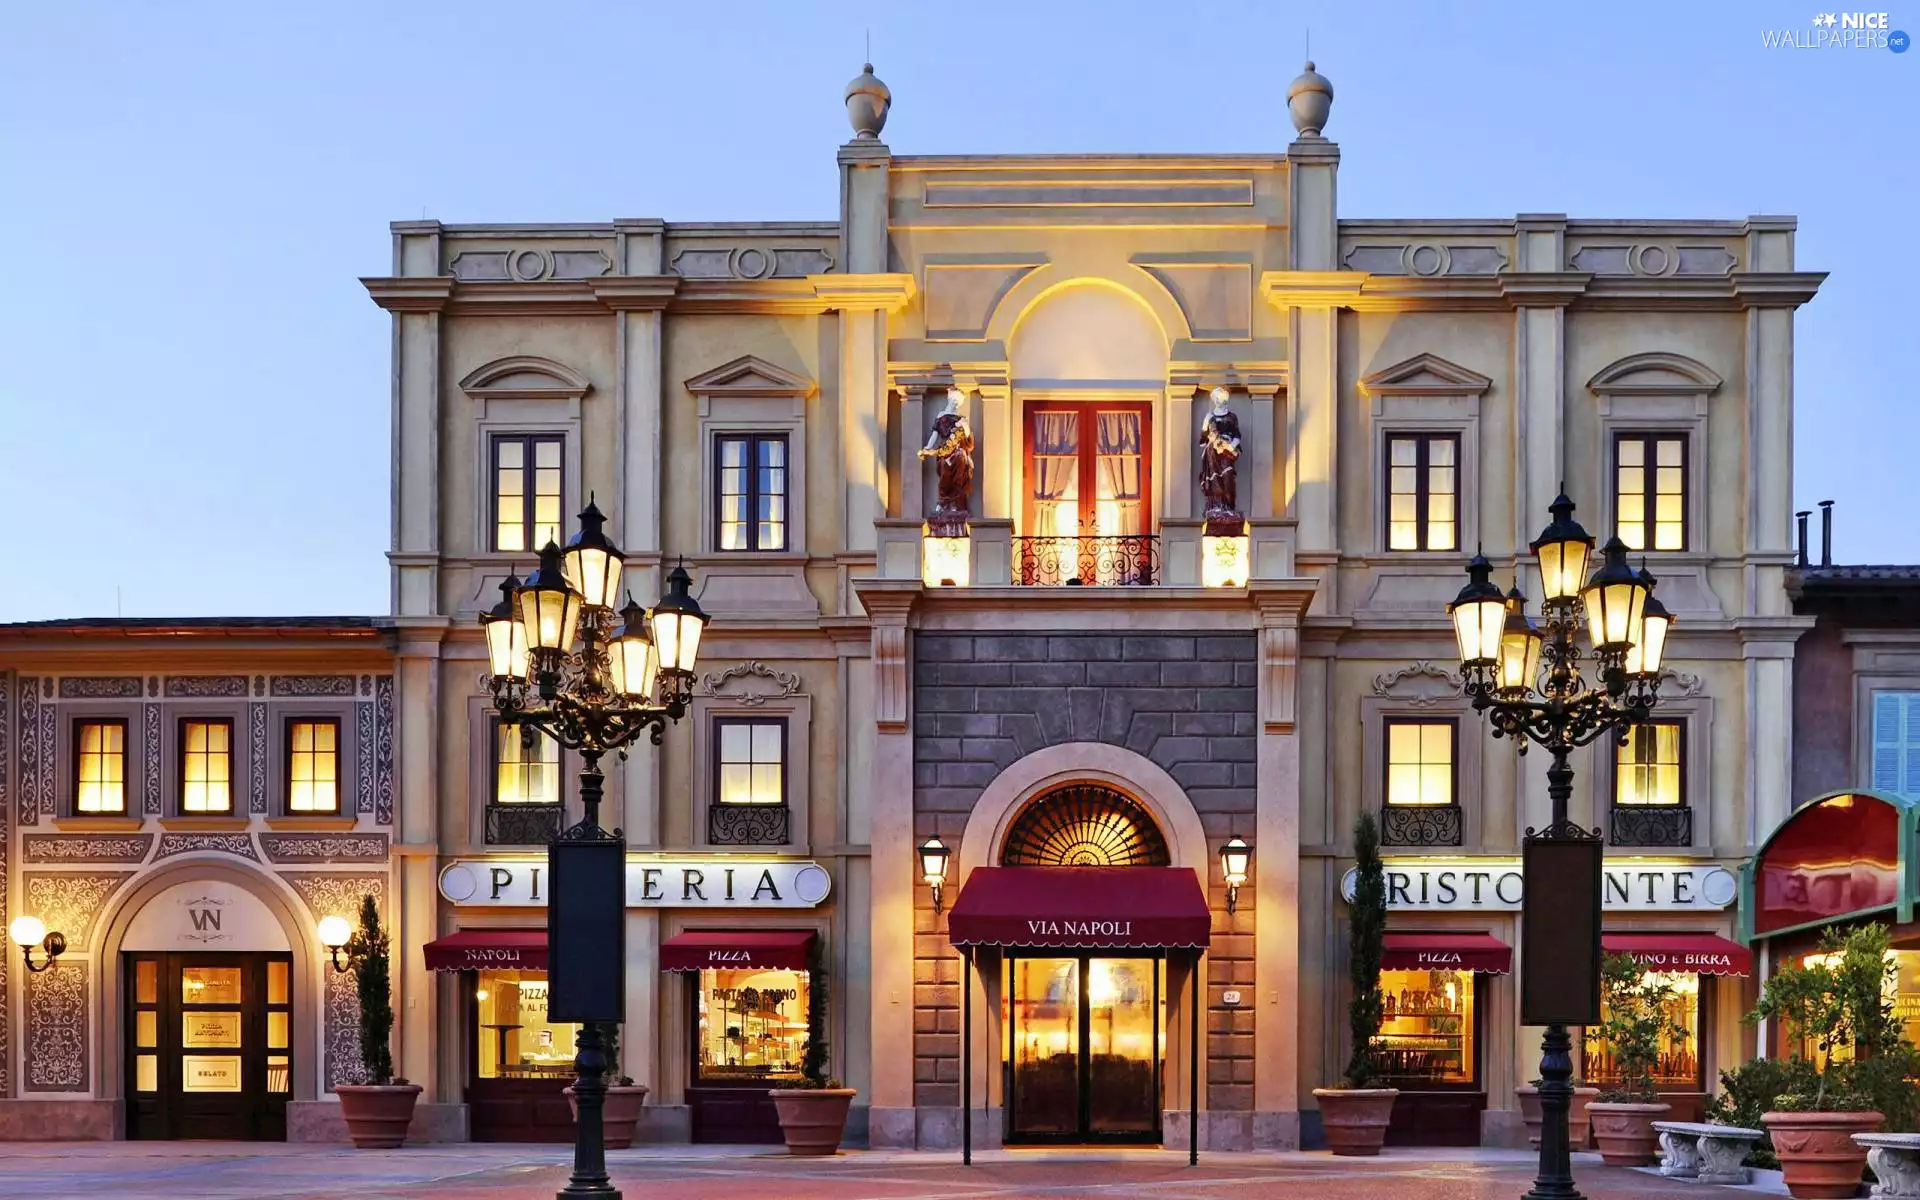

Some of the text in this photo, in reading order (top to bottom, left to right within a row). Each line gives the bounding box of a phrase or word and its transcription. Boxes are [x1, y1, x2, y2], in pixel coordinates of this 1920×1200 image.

[490, 868, 783, 900] PIERIA
[1387, 871, 1695, 905] RISTONTE
[1028, 920, 1132, 937] VIA NAPOLI
[465, 949, 521, 961] NAPOLI
[708, 950, 751, 961] PIZZA
[1418, 952, 1461, 963] PIZZA
[1685, 953, 1732, 966] BIRRA
